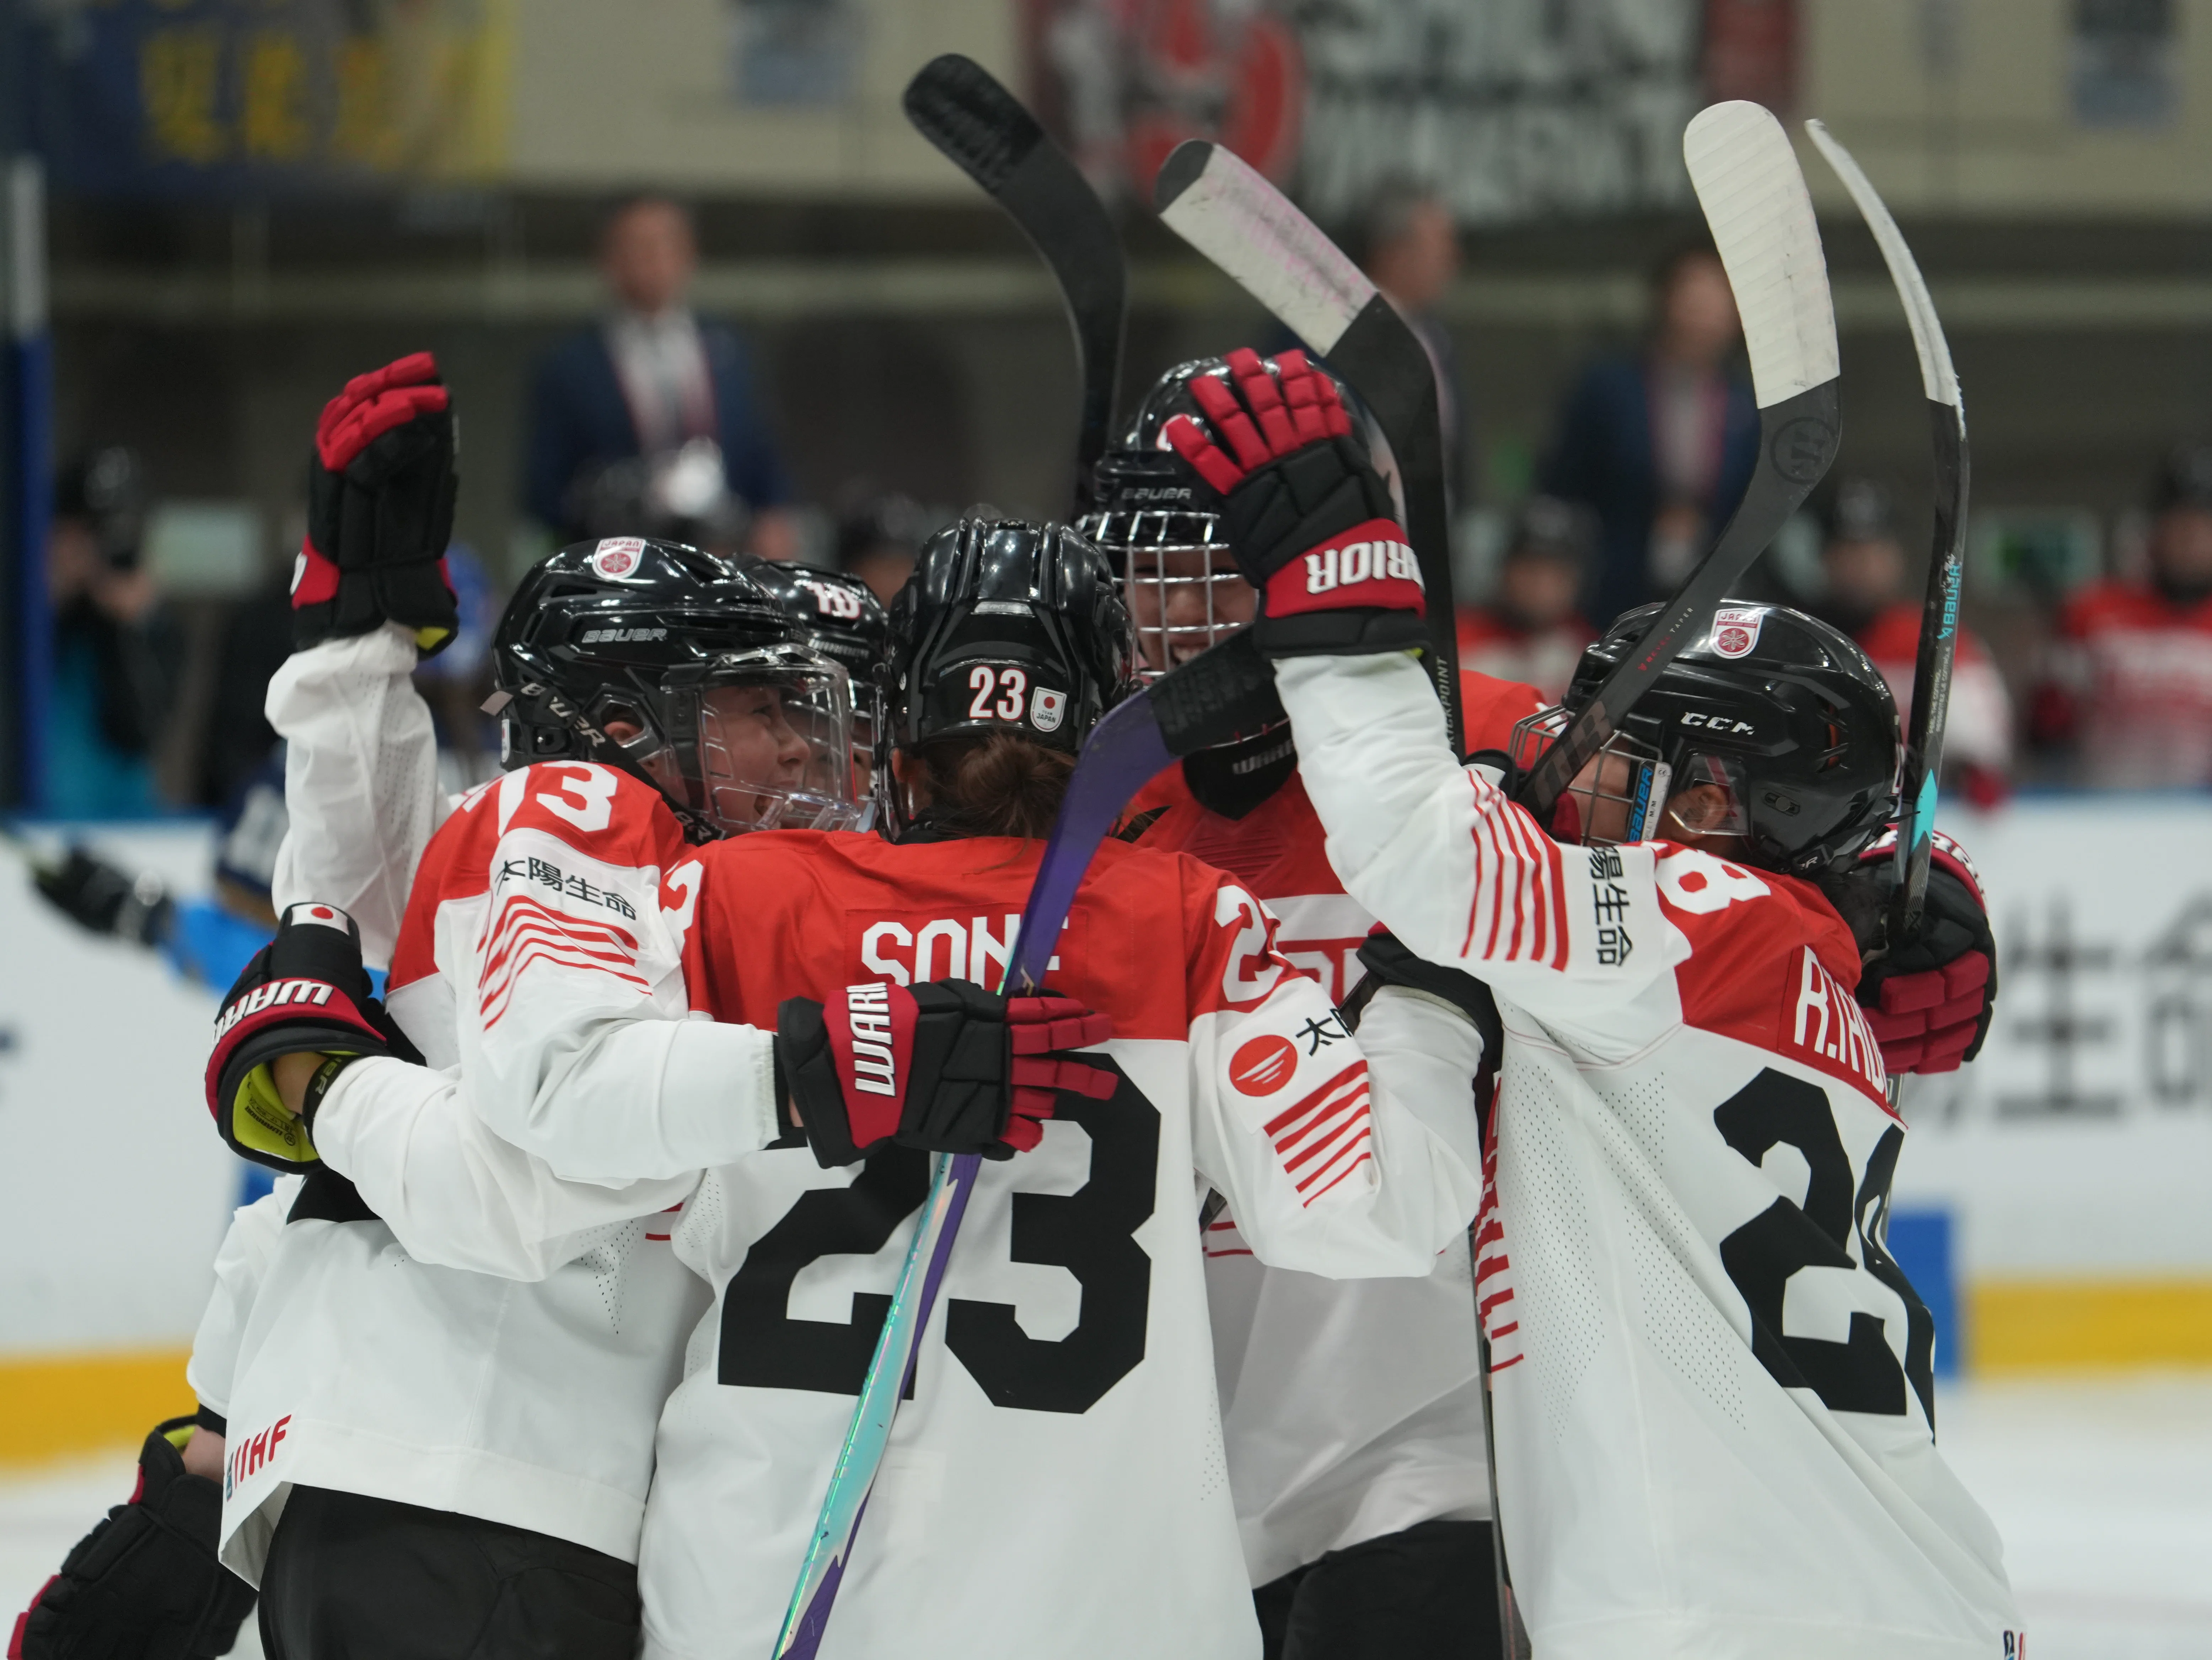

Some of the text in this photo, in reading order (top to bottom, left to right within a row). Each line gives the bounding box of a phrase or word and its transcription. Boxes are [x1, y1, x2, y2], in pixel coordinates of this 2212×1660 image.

[1121, 487, 1193, 500] BAUER
[582, 628, 668, 643] BAUER
[1669, 607, 1694, 634] TAPER
[1721, 613, 1756, 622] JAP
[969, 665, 1027, 721] 23
[1036, 713, 1056, 723] JAPAN
[1681, 712, 1755, 735] CCM
[1641, 840, 1771, 915] 8
[861, 914, 1068, 991] SON
[1214, 885, 1288, 1003] 2
[718, 1052, 1161, 1414] 23
[234, 1414, 292, 1489] IIHF
